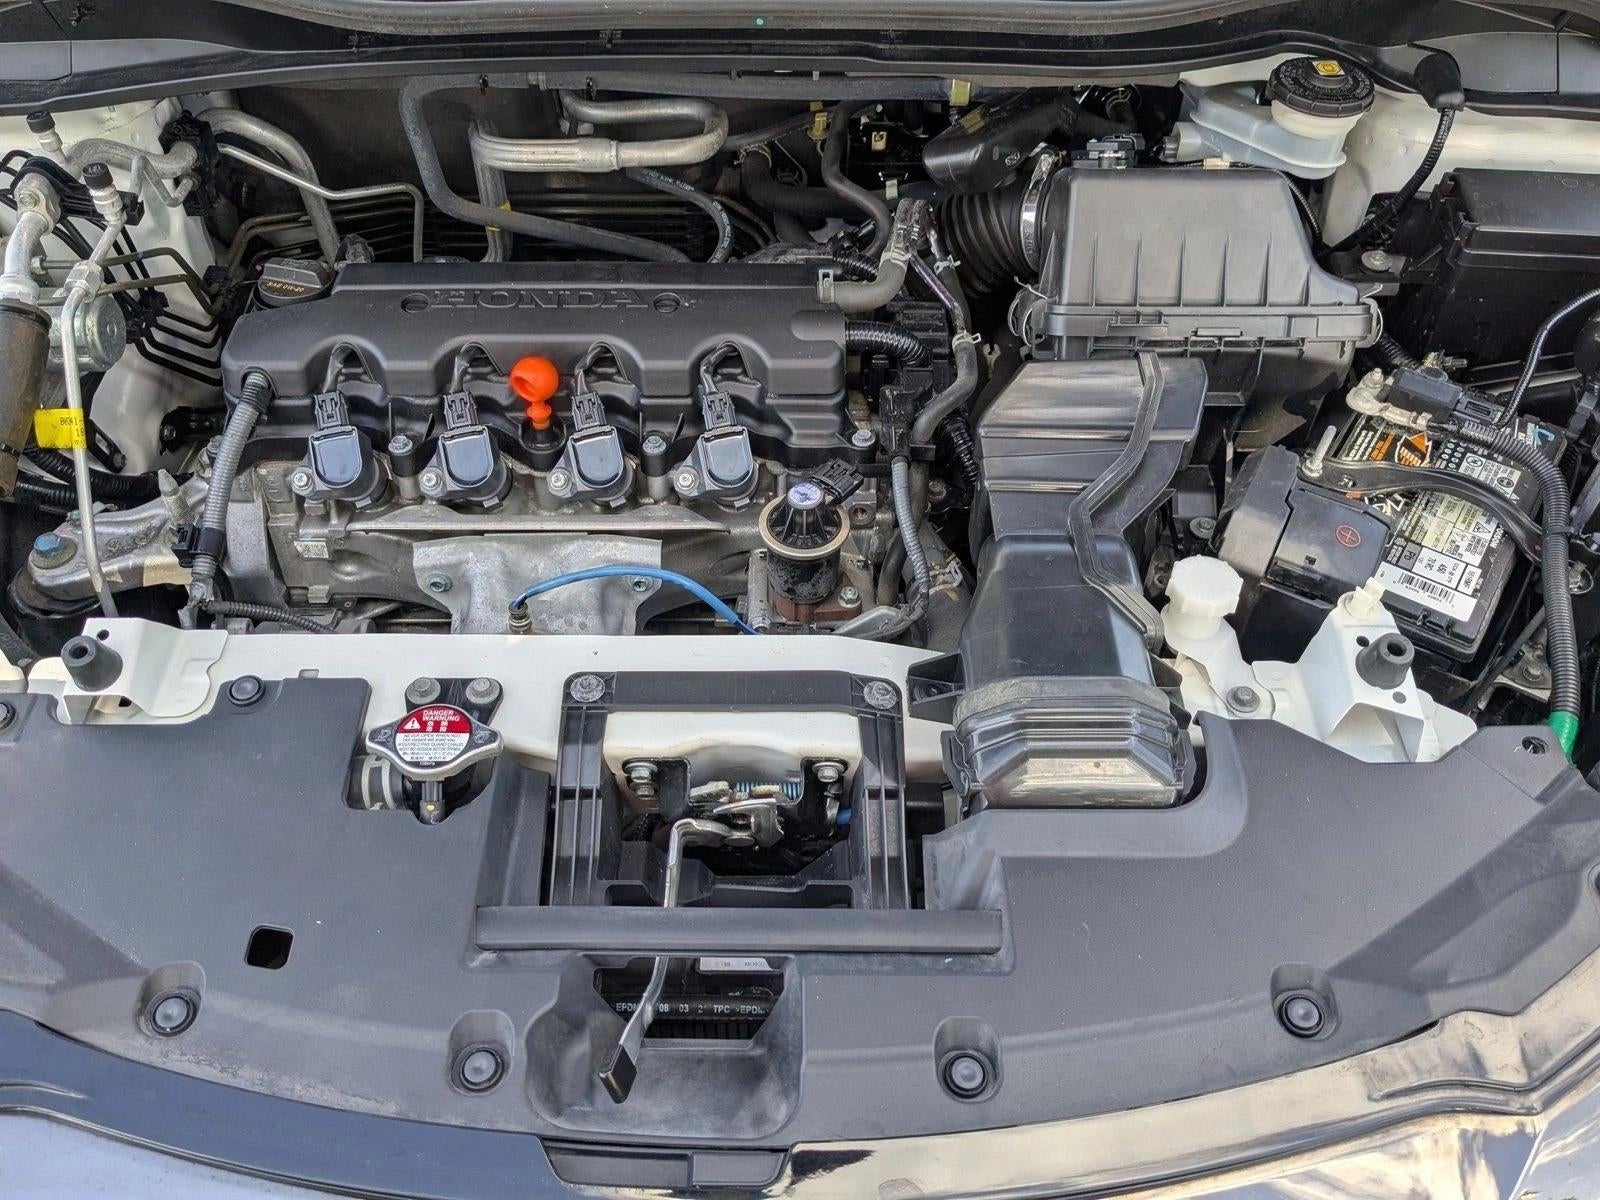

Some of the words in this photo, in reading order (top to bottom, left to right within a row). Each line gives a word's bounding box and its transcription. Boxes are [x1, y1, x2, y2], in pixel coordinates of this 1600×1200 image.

[430, 290, 649, 309] HONDA
[1489, 525, 1504, 548] POISON
[1404, 549, 1416, 561] Pb
[658, 1003, 669, 1012] 08
[678, 1004, 689, 1013] 03
[713, 1004, 730, 1013] TPC
